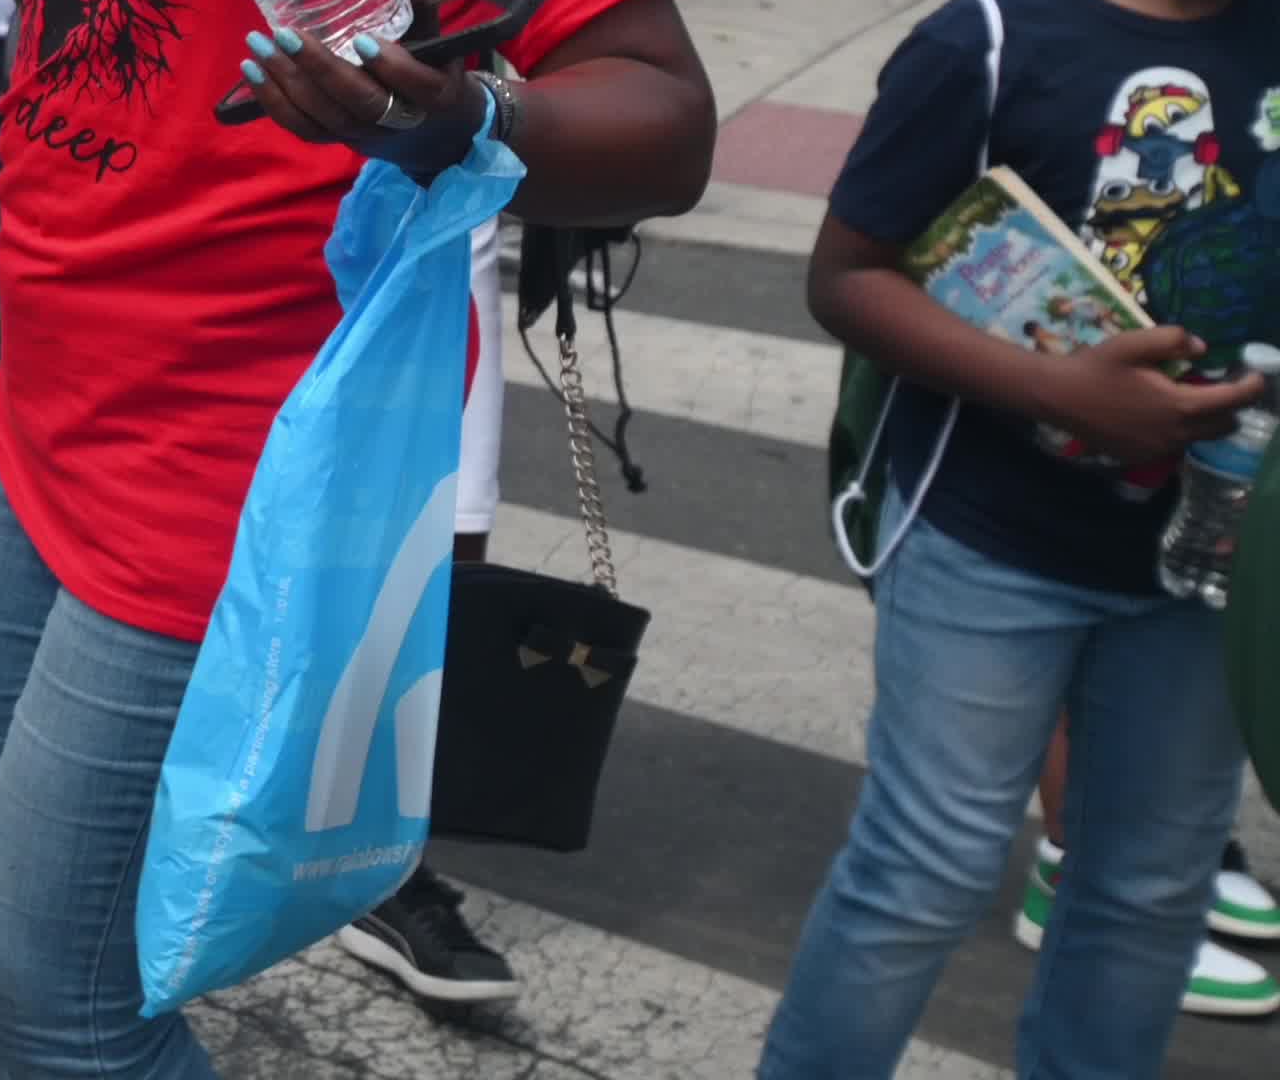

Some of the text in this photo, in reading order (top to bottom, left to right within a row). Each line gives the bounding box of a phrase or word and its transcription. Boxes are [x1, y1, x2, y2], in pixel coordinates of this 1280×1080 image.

[16, 92, 137, 184] deep
[242, 679, 280, 777] participating
[266, 636, 283, 678] store
